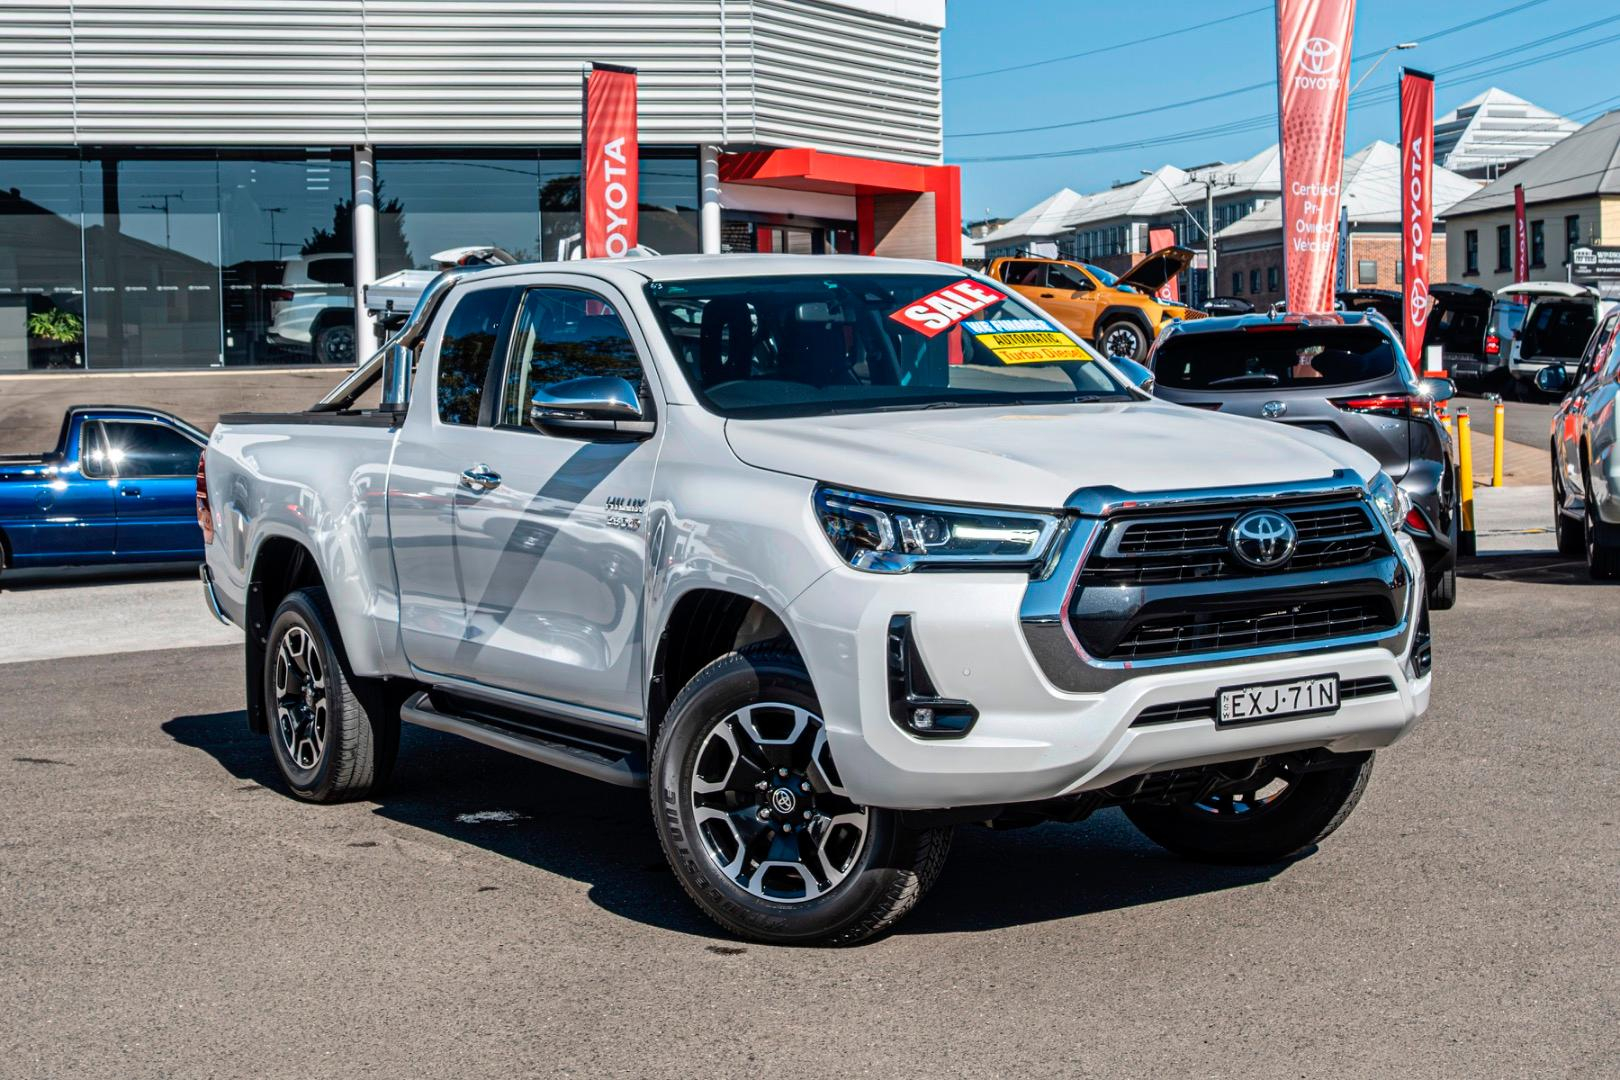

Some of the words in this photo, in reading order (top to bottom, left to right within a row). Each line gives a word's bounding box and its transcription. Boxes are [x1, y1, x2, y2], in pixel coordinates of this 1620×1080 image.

[1292, 181, 1340, 196] Certied
[604, 137, 628, 258] OYOTA
[1411, 137, 1423, 266] TOYOTA
[1304, 200, 1323, 215] Pr-
[1296, 219, 1335, 233] Owed
[1293, 238, 1334, 252] Vecle
[904, 283, 999, 330] SALE
[992, 333, 1060, 346] AUTOMATIC
[1000, 350, 1041, 361] Turbo
[1041, 347, 1088, 359] Diesel
